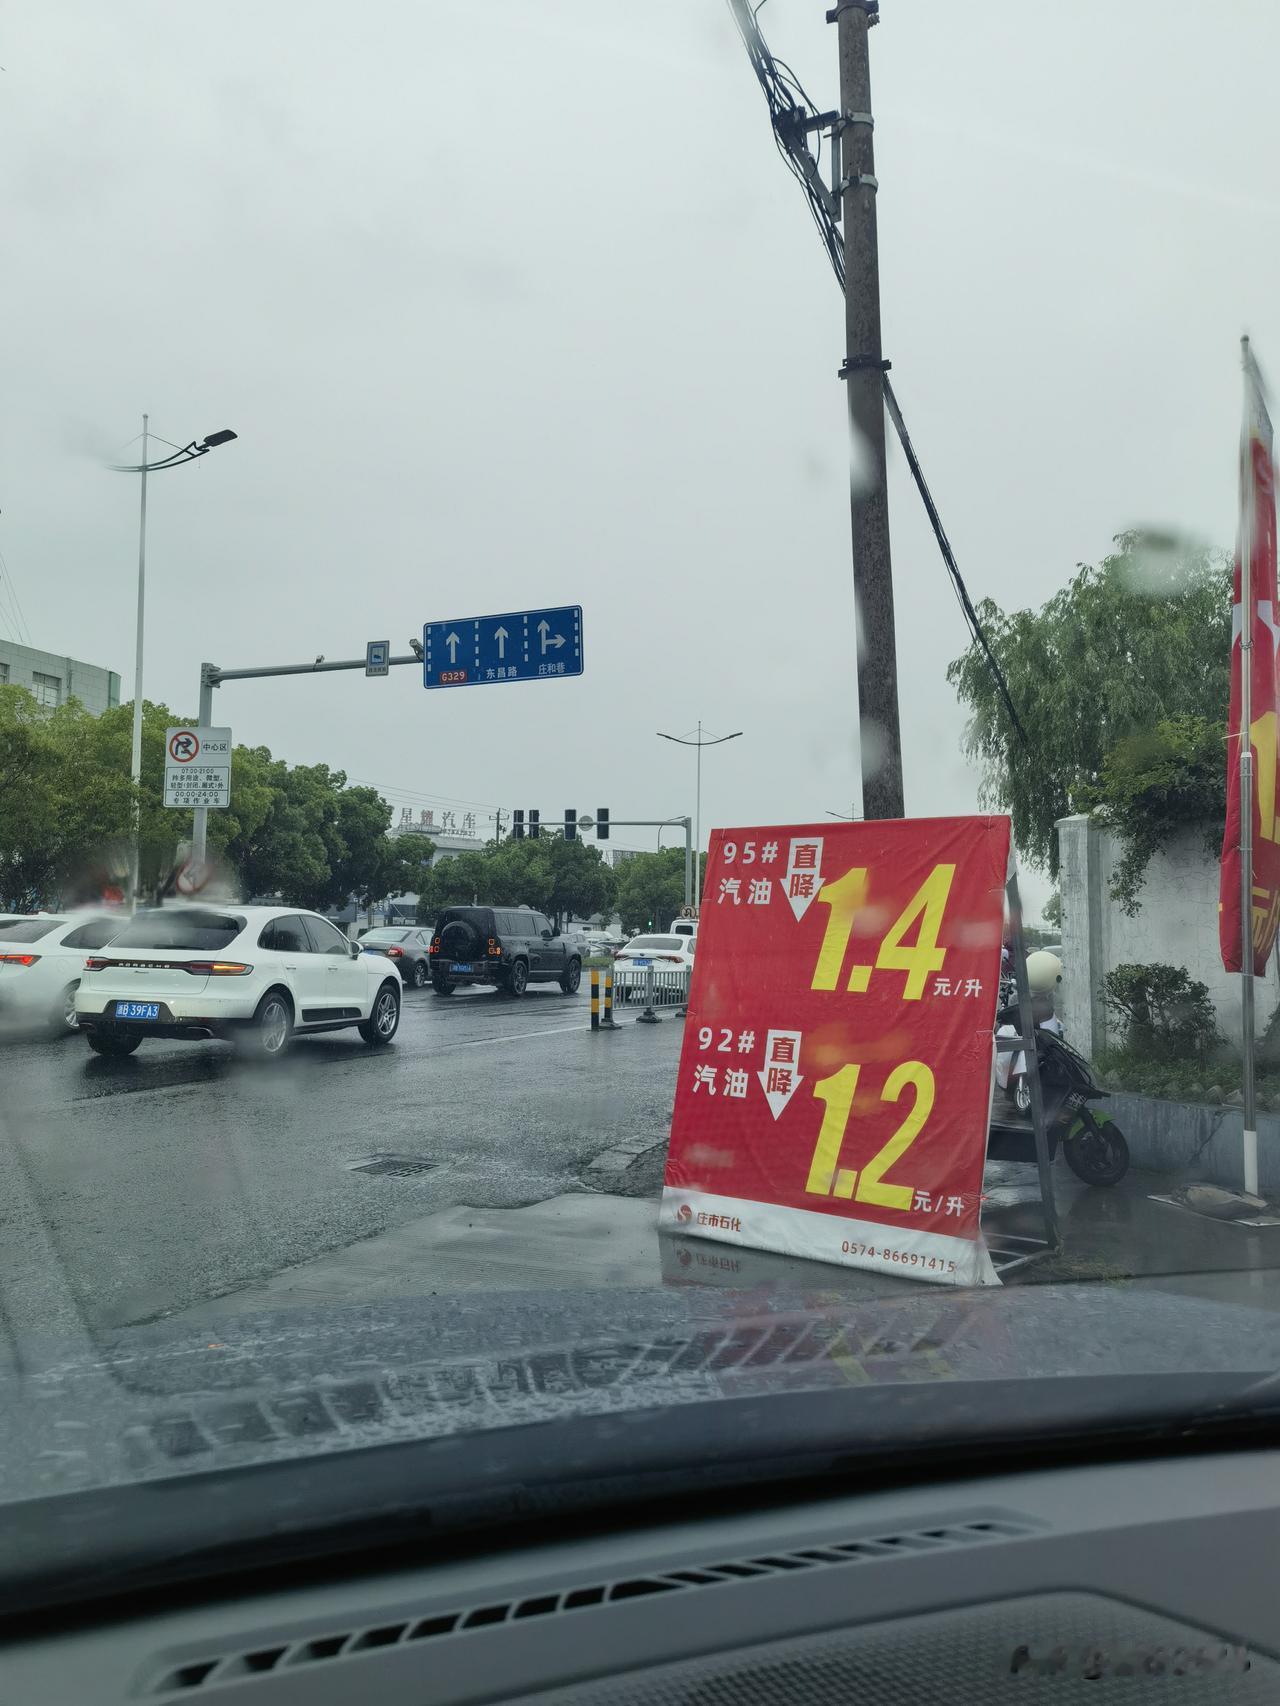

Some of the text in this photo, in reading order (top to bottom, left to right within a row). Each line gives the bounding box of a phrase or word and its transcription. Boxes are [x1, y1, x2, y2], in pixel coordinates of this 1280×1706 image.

[441, 671, 466, 682] G329
[486, 666, 518, 679] 东昌路
[538, 663, 566, 675] 庄和巷
[203, 743, 227, 751] 中心区
[723, 841, 779, 865] 95#
[788, 843, 818, 900] 直降
[717, 878, 772, 906] 汽油
[811, 864, 956, 1000] 1.4
[933, 978, 983, 998] 元/升
[698, 1027, 755, 1054] 92#
[766, 1036, 797, 1096] 直降
[692, 1064, 749, 1099] 汽油
[805, 1061, 935, 1211] 1.2
[913, 1191, 965, 1217] 元/升
[696, 1211, 742, 1233] 庄市石化
[841, 1240, 956, 1274] 0574-86691415
